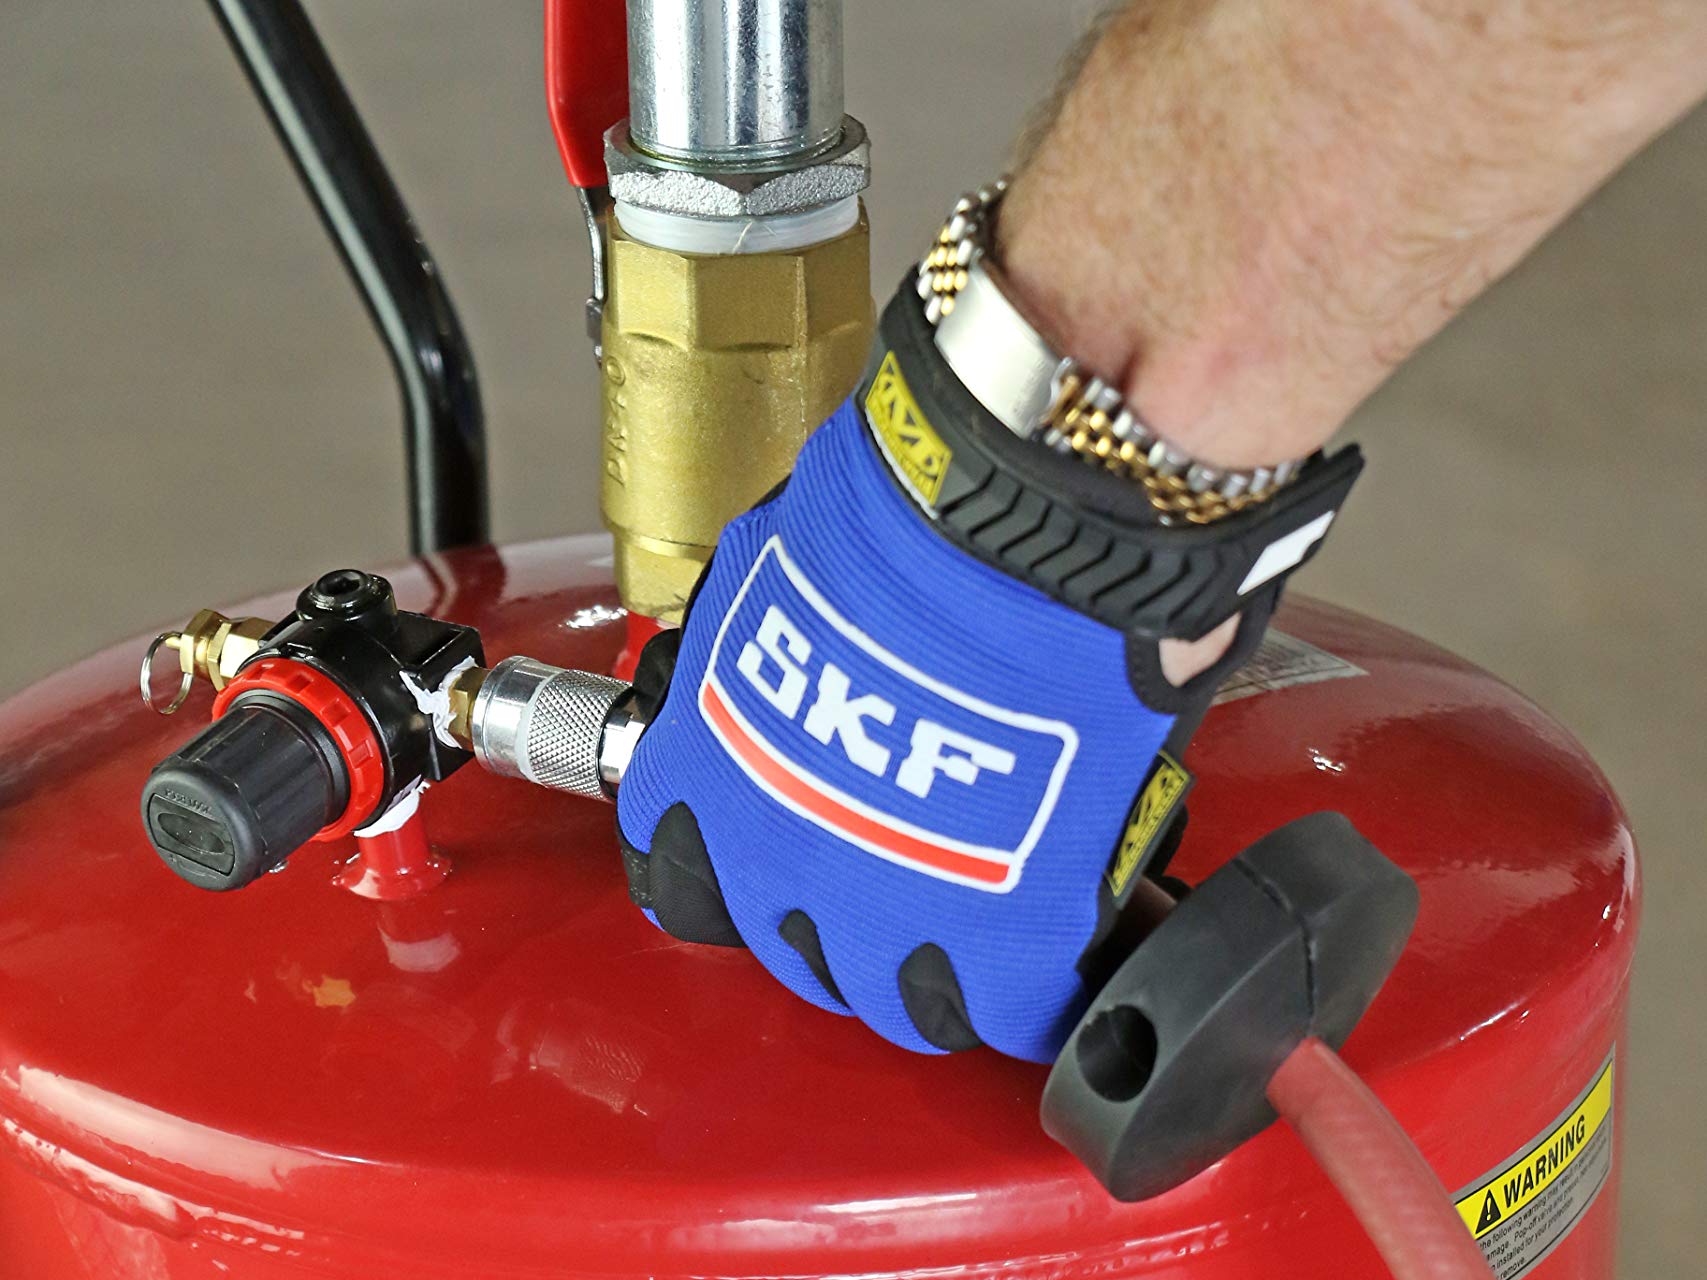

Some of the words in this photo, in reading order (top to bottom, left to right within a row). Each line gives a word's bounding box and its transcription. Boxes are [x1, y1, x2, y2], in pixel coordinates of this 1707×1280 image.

[736, 604, 1016, 798] SKF
[1503, 1114, 1585, 1208] WARNING
[1492, 1216, 1522, 1243] following
[1523, 1196, 1547, 1221] warning
[1496, 1243, 1525, 1270] installed
